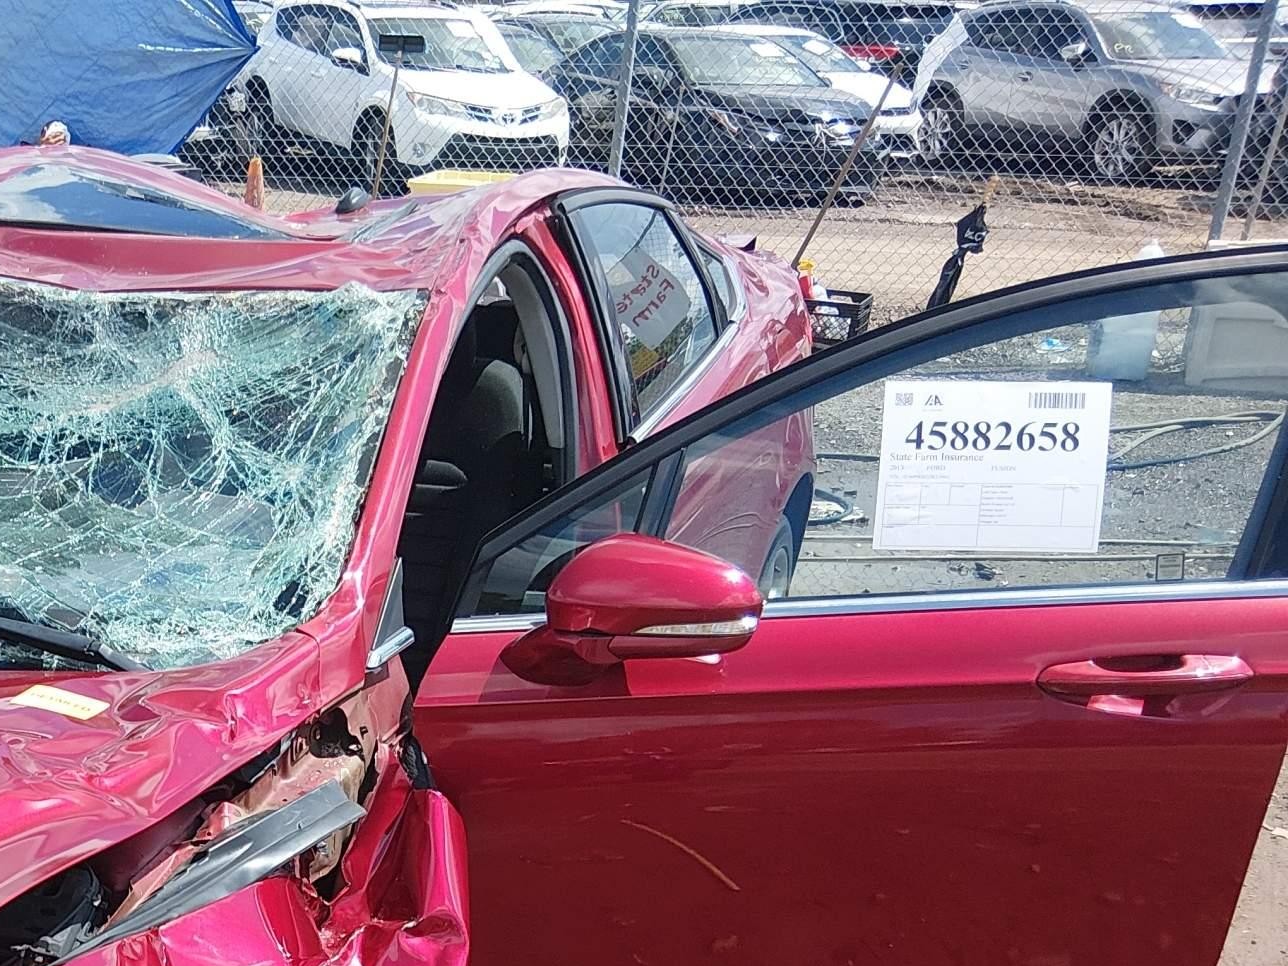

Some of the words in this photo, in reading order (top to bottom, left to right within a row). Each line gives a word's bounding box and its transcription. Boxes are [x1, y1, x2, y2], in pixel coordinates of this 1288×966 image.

[904, 420, 1080, 452] 45882658
[889, 453, 913, 462] State
[915, 453, 938, 462] Farm
[940, 453, 984, 462] Insurance
